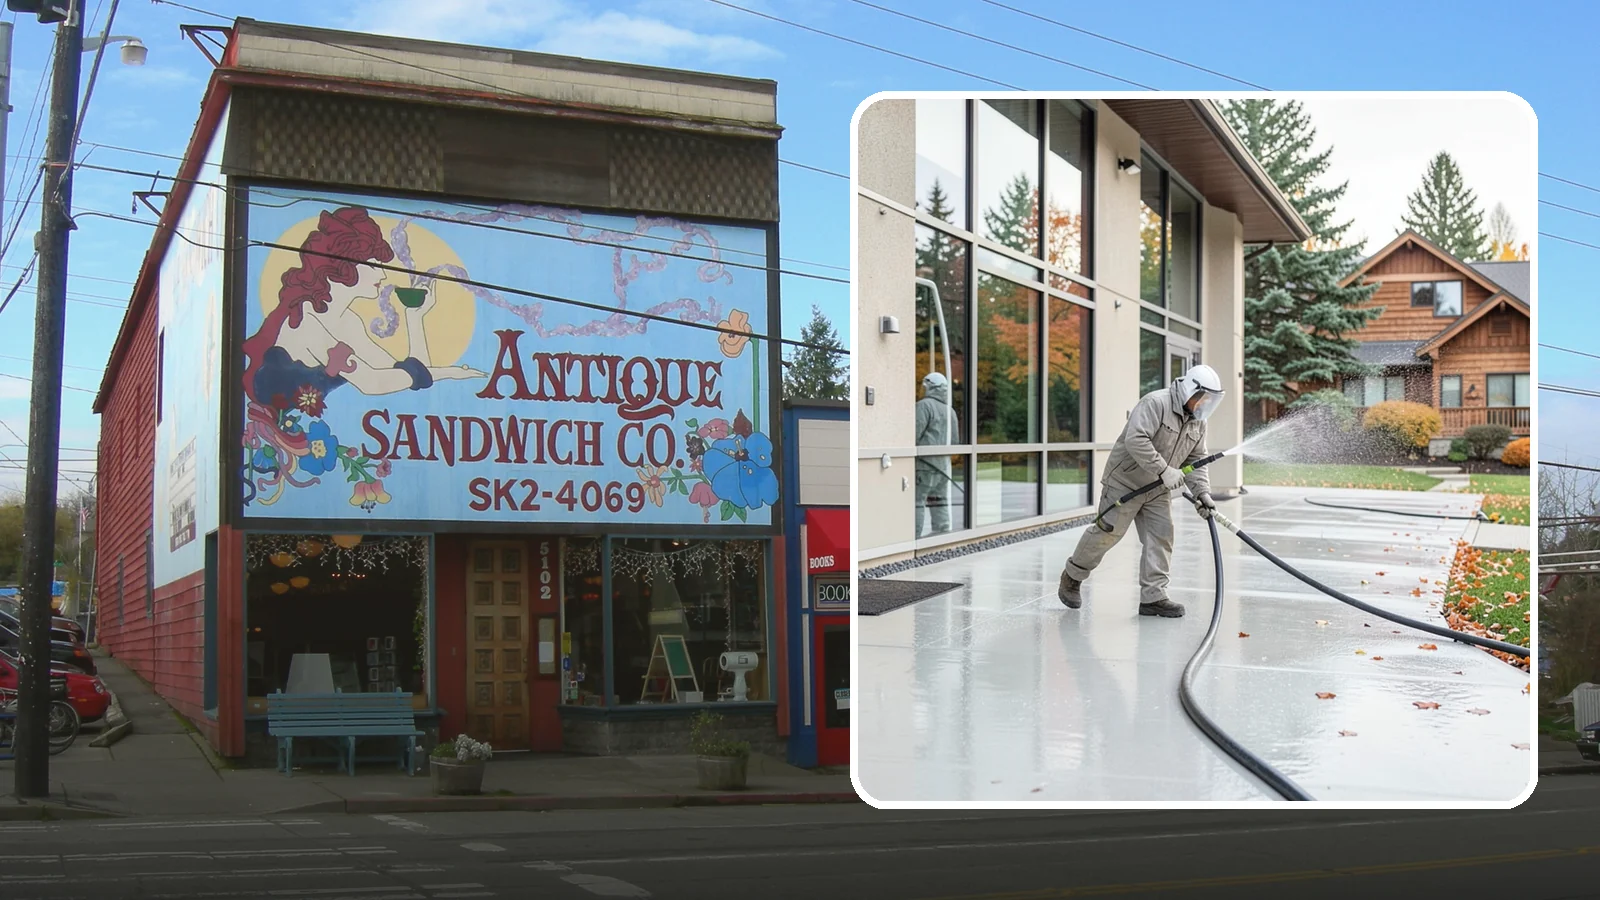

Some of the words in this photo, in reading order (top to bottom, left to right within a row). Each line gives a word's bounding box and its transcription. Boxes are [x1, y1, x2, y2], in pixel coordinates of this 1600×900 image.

[475, 329, 724, 421] ANTIQUE
[361, 408, 604, 467] SANDWICH
[617, 421, 685, 469] CO.
[468, 477, 646, 513] SK2-4069
[540, 541, 551, 599] 5102
[809, 555, 835, 568] BOOKS
